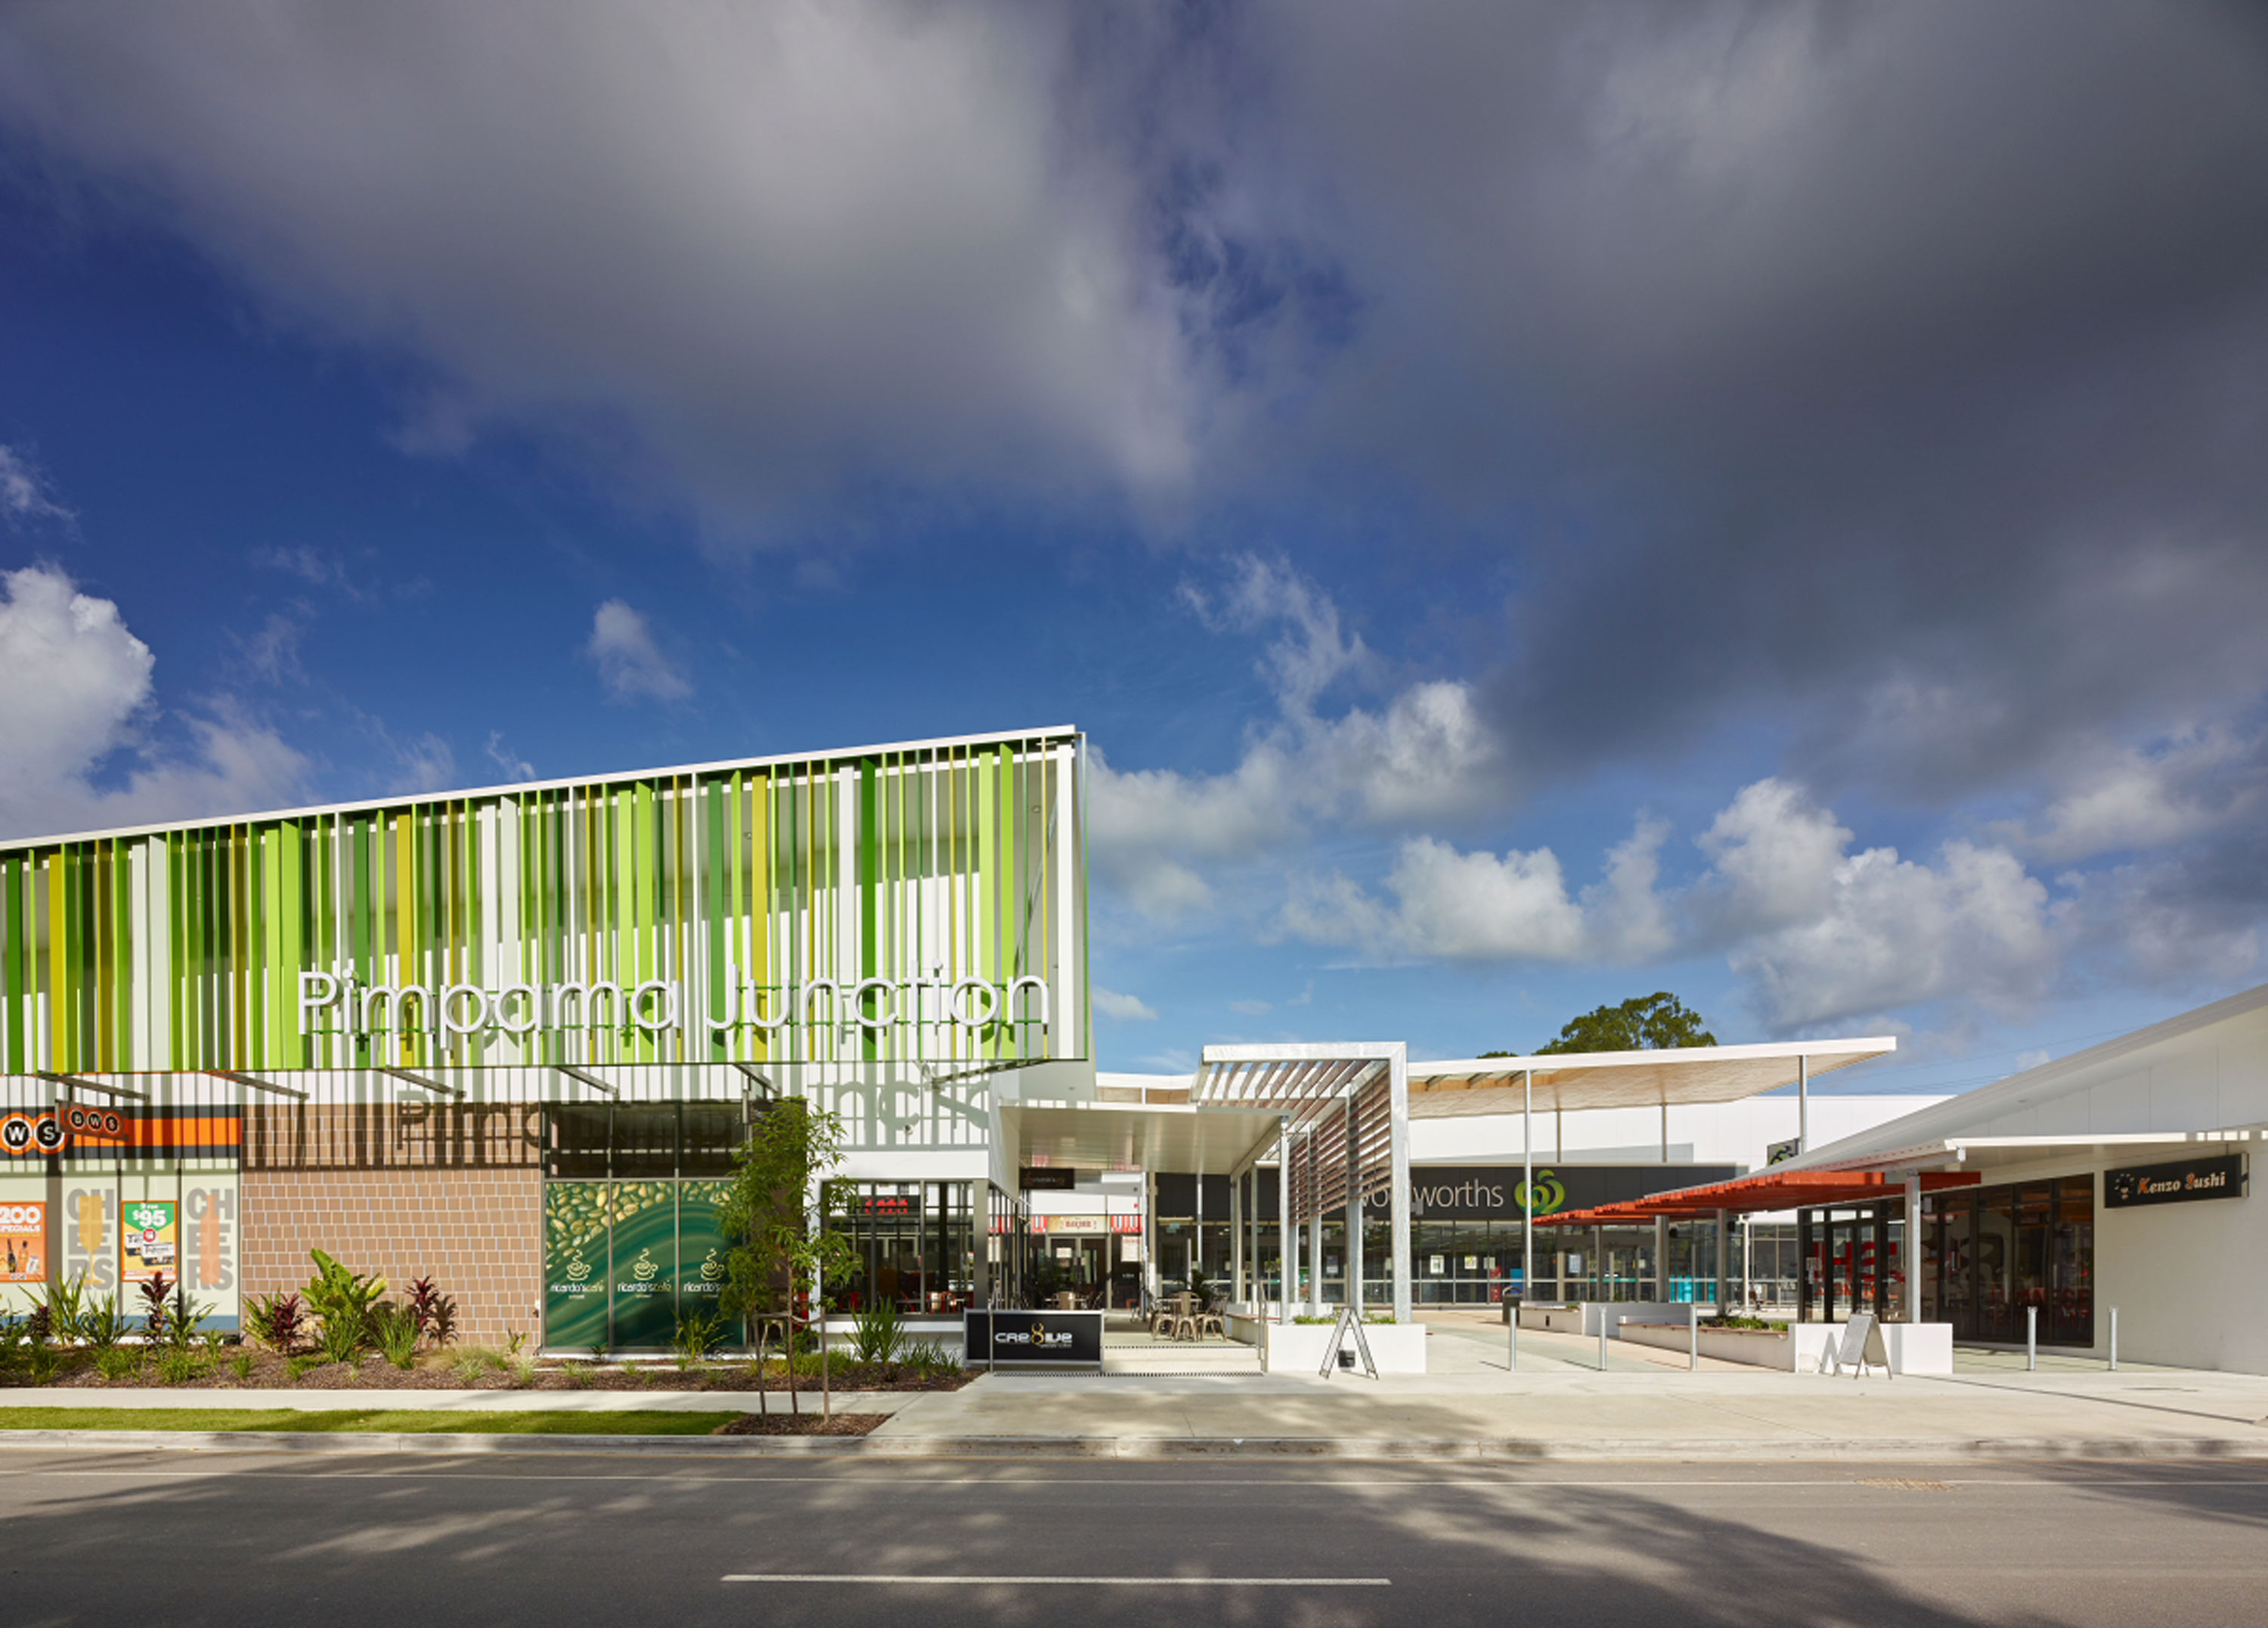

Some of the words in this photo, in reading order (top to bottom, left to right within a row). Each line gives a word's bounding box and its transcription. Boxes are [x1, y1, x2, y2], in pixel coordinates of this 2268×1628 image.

[298, 969, 682, 1050] Pimpama
[706, 958, 1049, 1029] Junction
[73, 1112, 117, 1130] BWS
[1362, 1178, 1504, 1208] oworths
[2137, 1177, 2181, 1194] Kenzo
[2185, 1171, 2226, 1190] Sushi
[132, 1210, 166, 1226] $95
